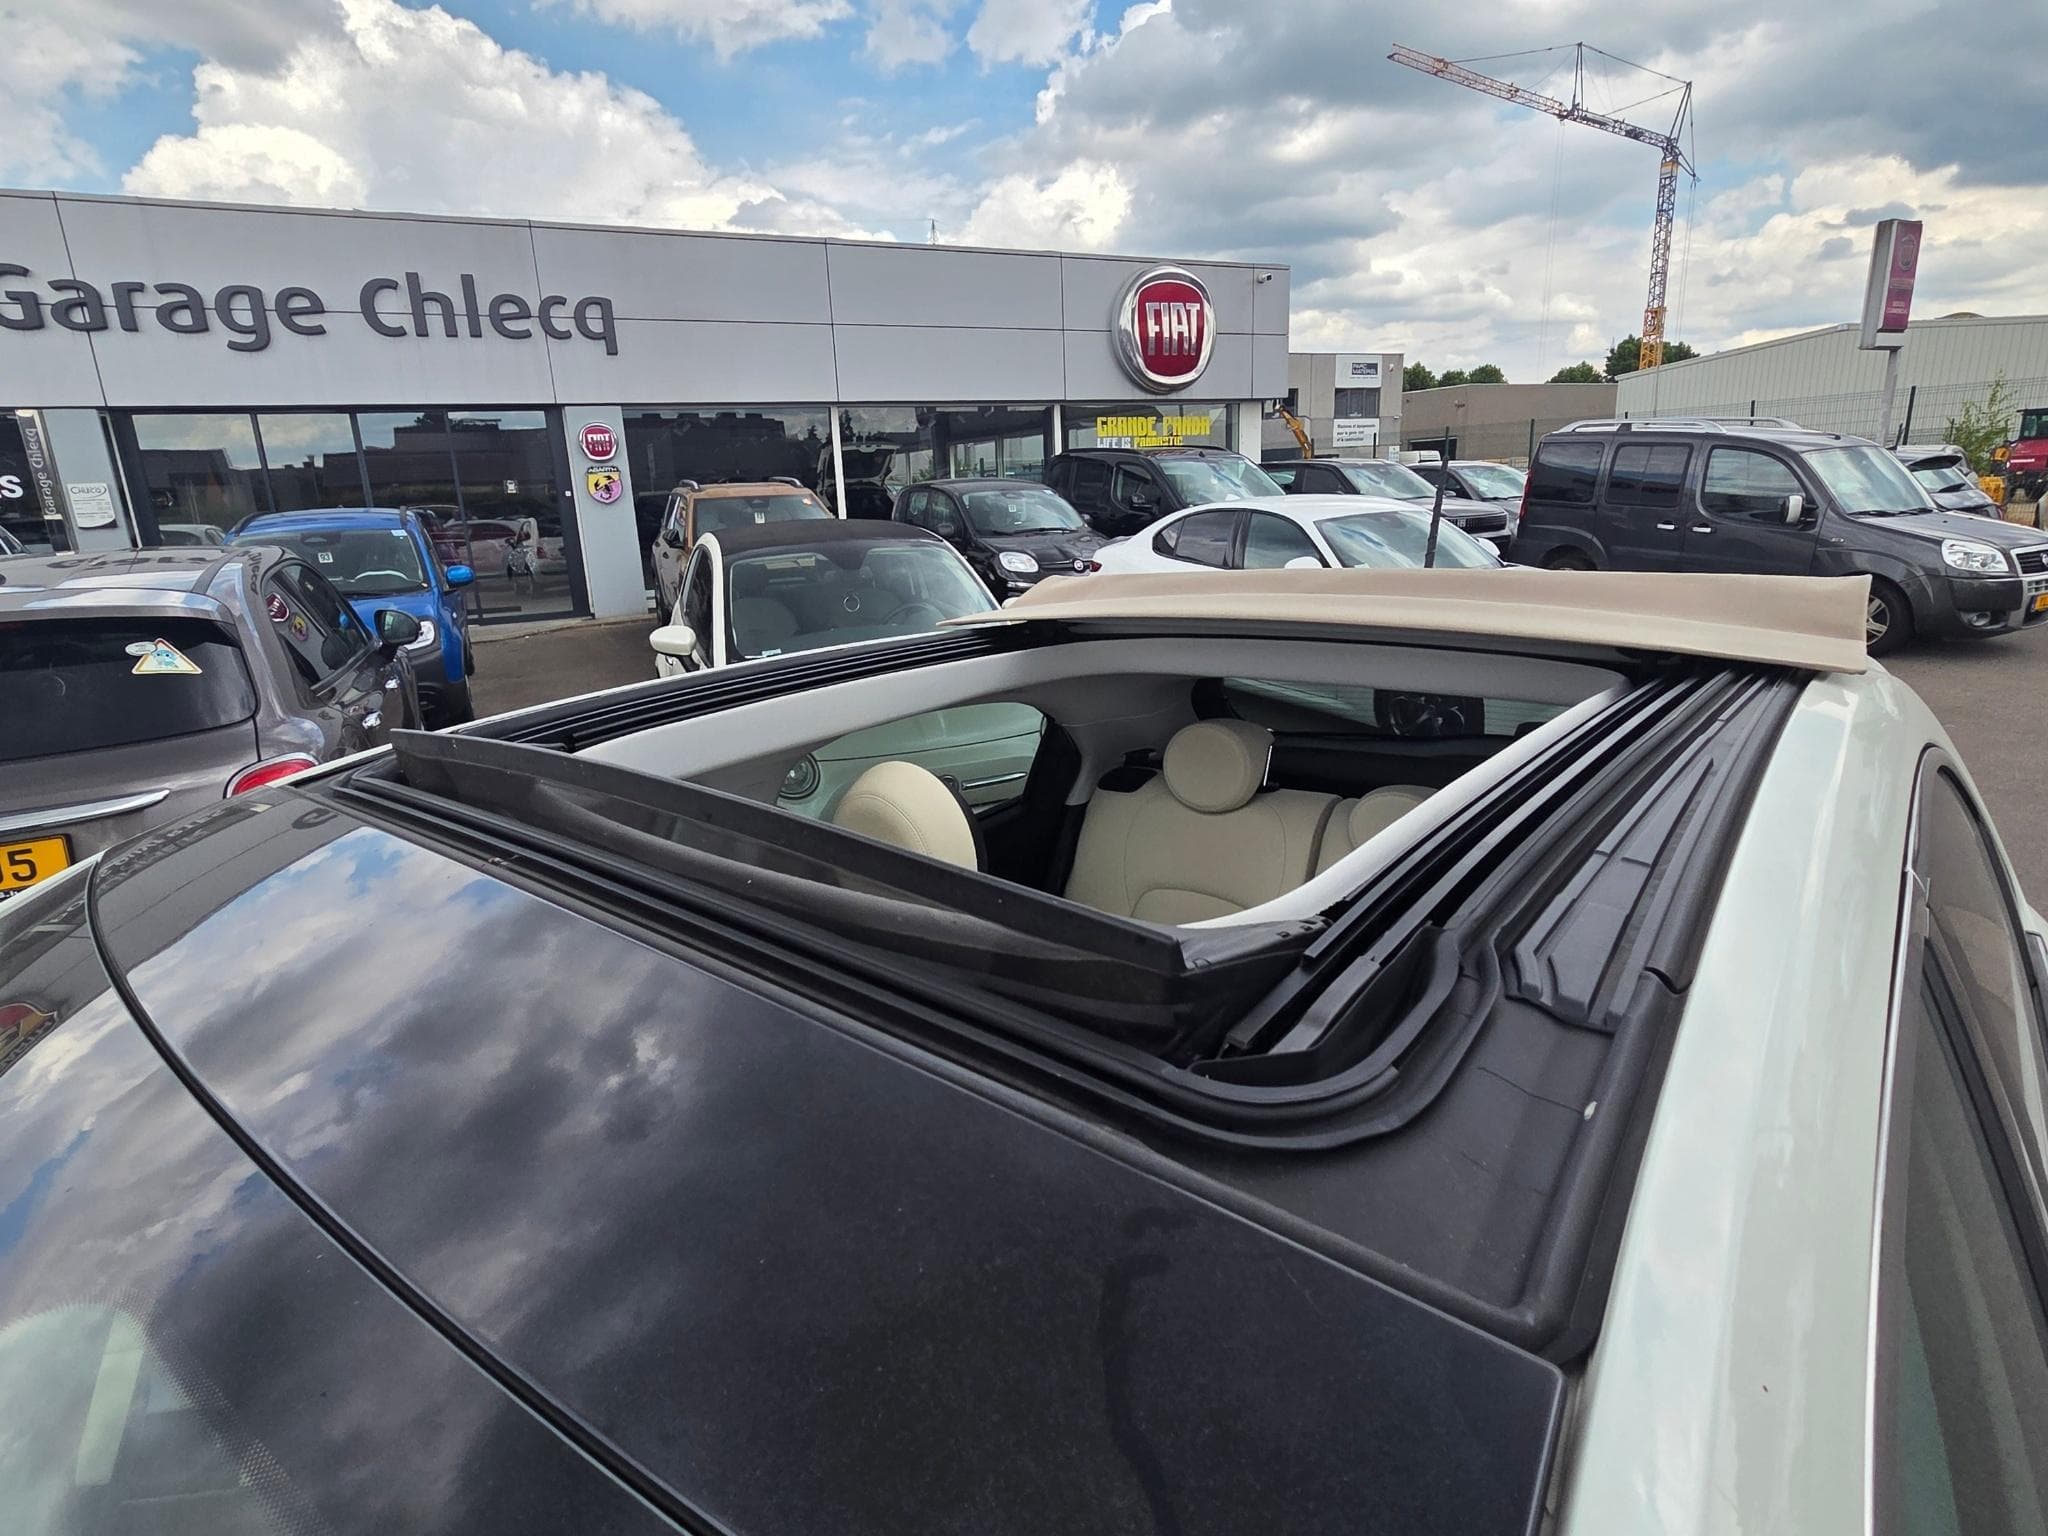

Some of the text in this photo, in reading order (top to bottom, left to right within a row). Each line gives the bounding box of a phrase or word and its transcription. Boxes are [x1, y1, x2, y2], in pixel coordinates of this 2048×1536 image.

[0, 263, 619, 356] Garage Chlecq
[1145, 302, 1201, 356] FIAT
[1096, 415, 1212, 437] GRANDE PANDA
[1121, 437, 1131, 449] IS
[25, 427, 57, 515] Garage Chlecq
[0, 847, 38, 884] 5
